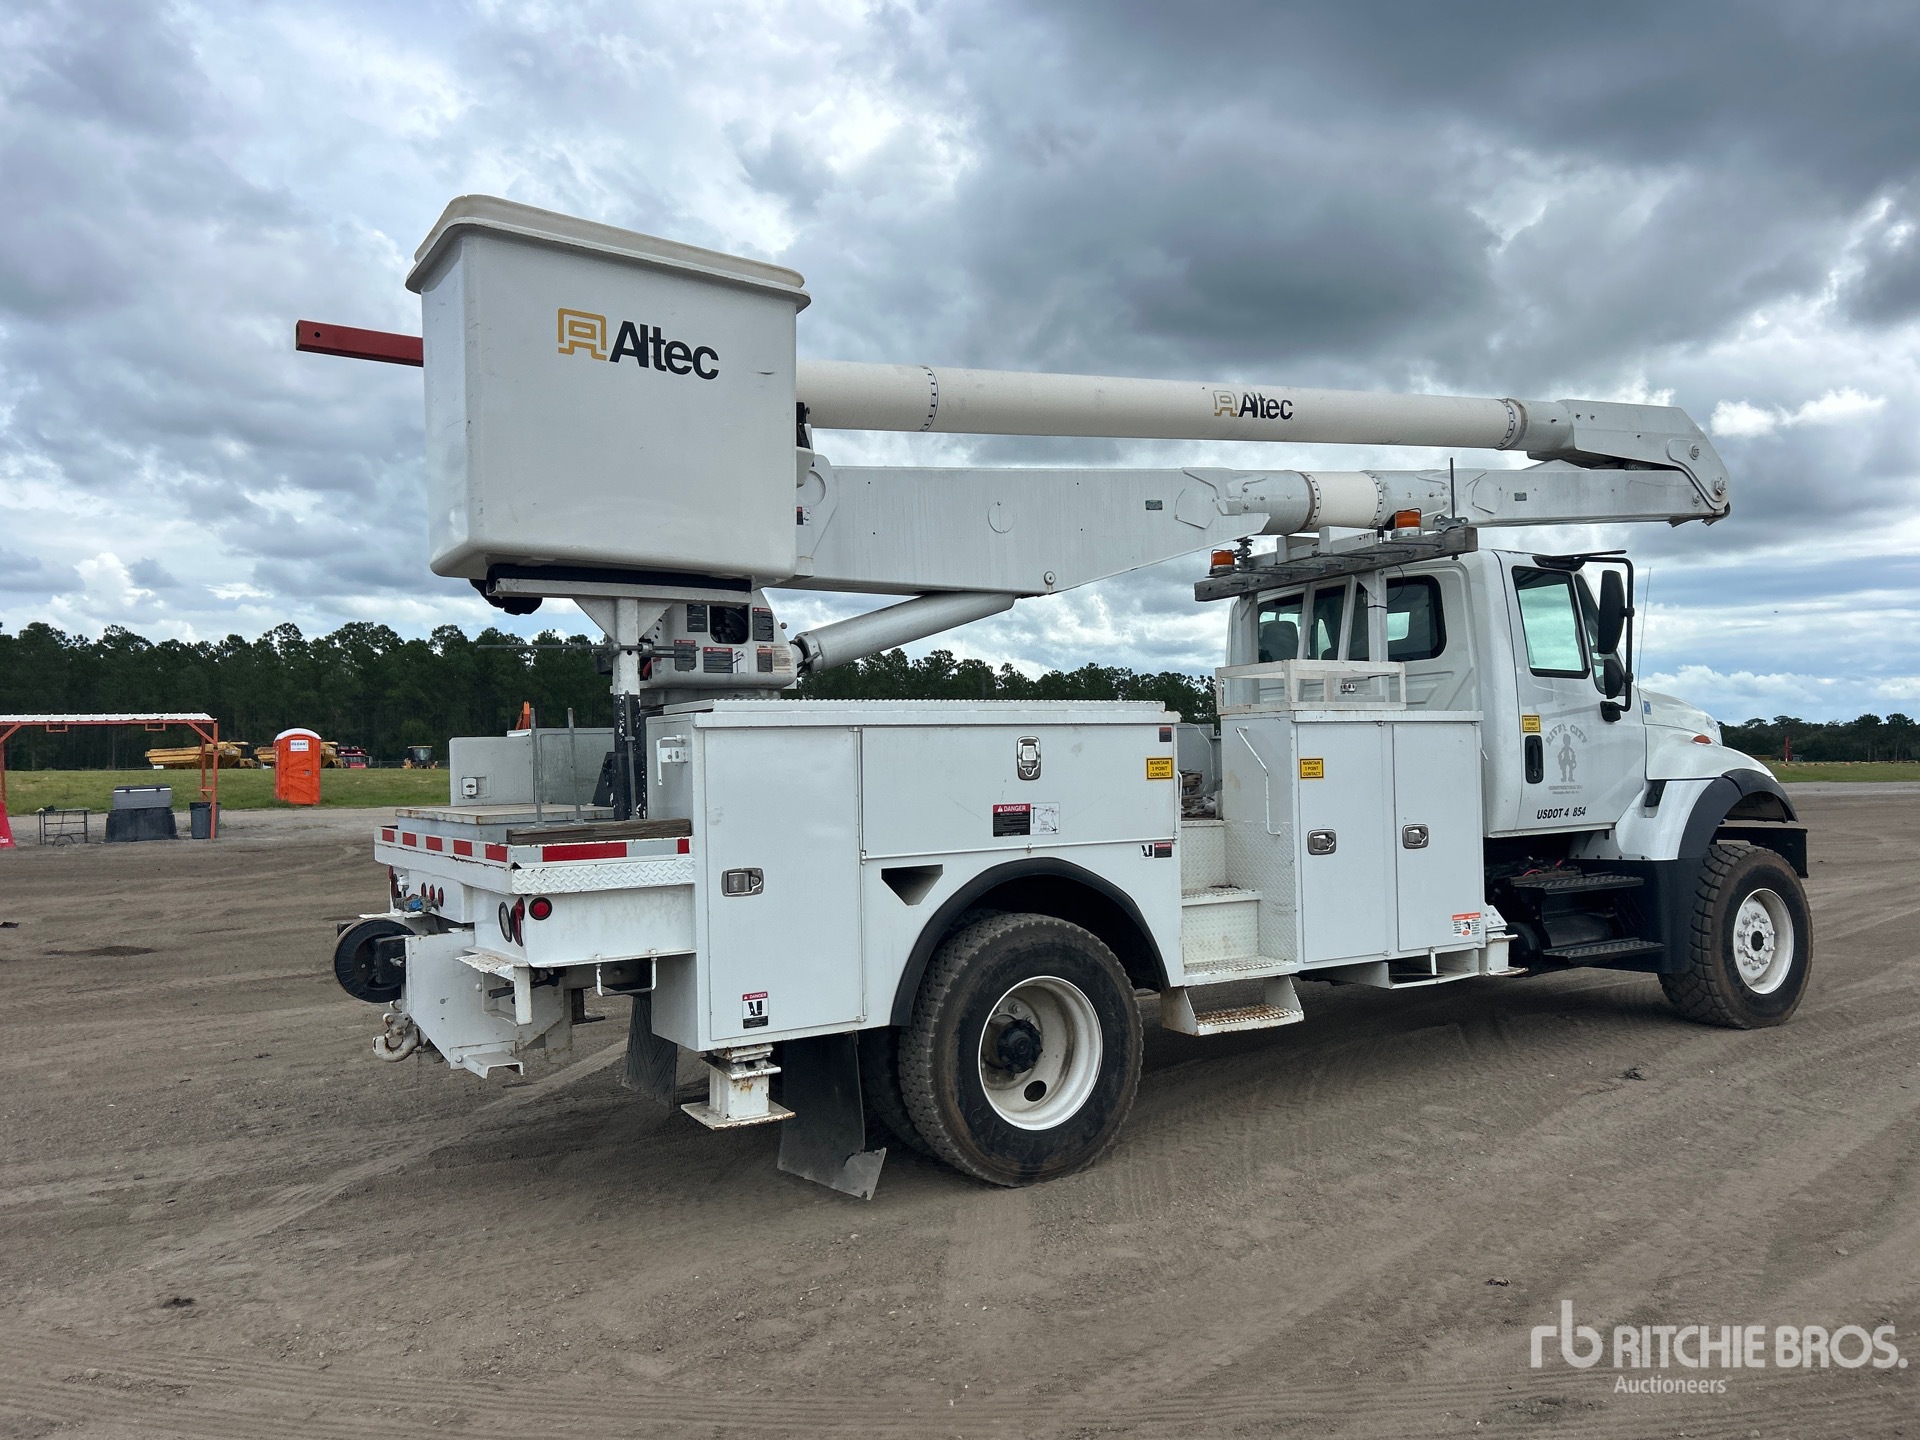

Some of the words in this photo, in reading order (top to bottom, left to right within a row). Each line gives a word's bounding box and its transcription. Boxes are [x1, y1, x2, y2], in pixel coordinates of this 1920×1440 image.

[609, 320, 719, 380] Altec
[1238, 392, 1293, 420] Altec
[1536, 808, 1564, 820] USDOT
[1564, 807, 1570, 817] 4
[1572, 806, 1586, 817] 854
